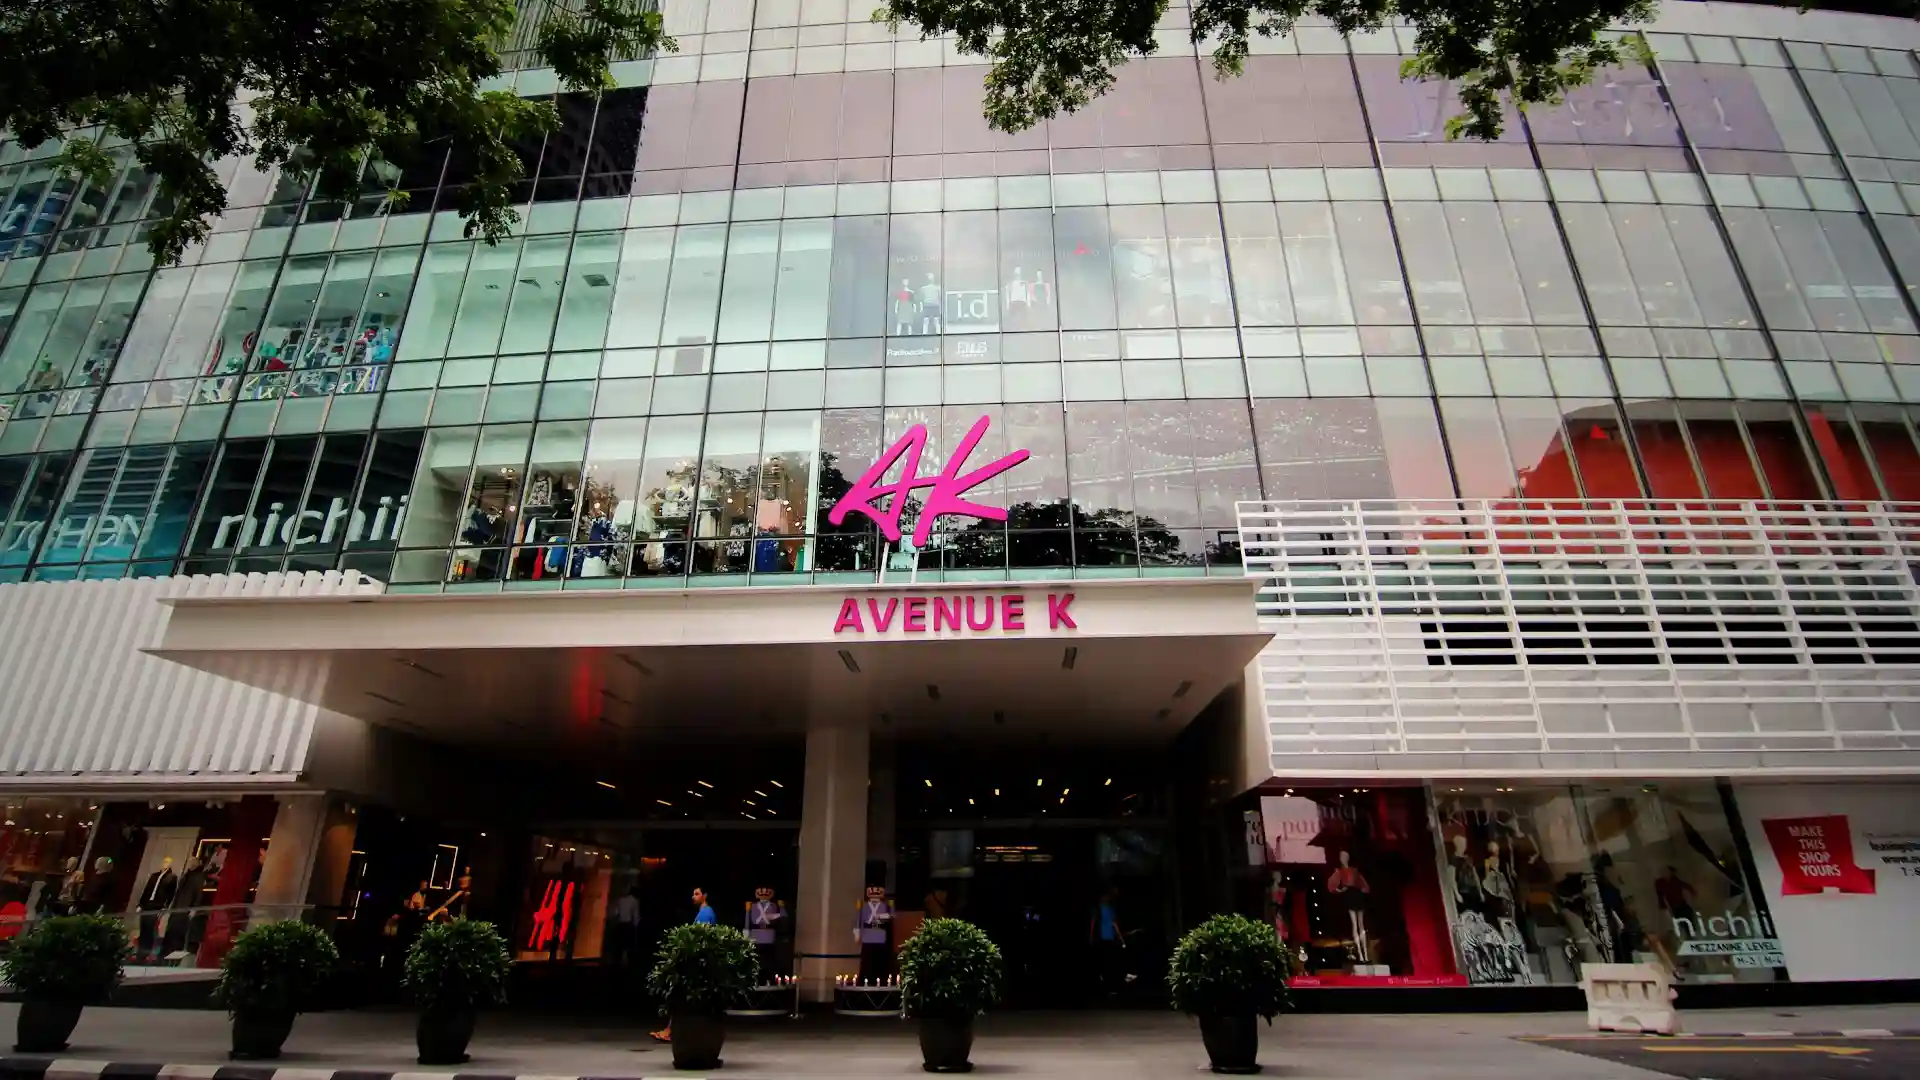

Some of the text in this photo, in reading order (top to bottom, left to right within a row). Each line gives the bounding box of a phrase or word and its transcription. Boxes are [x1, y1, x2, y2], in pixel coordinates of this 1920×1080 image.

[828, 415, 1031, 548] AK
[211, 495, 409, 550] nichii
[833, 592, 1078, 634] AVENUE K
[1788, 825, 1825, 838] MAKE
[1797, 838, 1826, 850] THIS
[1797, 851, 1832, 864] SHOP
[1799, 864, 1842, 877] YOURS
[1671, 909, 1774, 938] nichii
[1746, 940, 1778, 953] LEVEL
